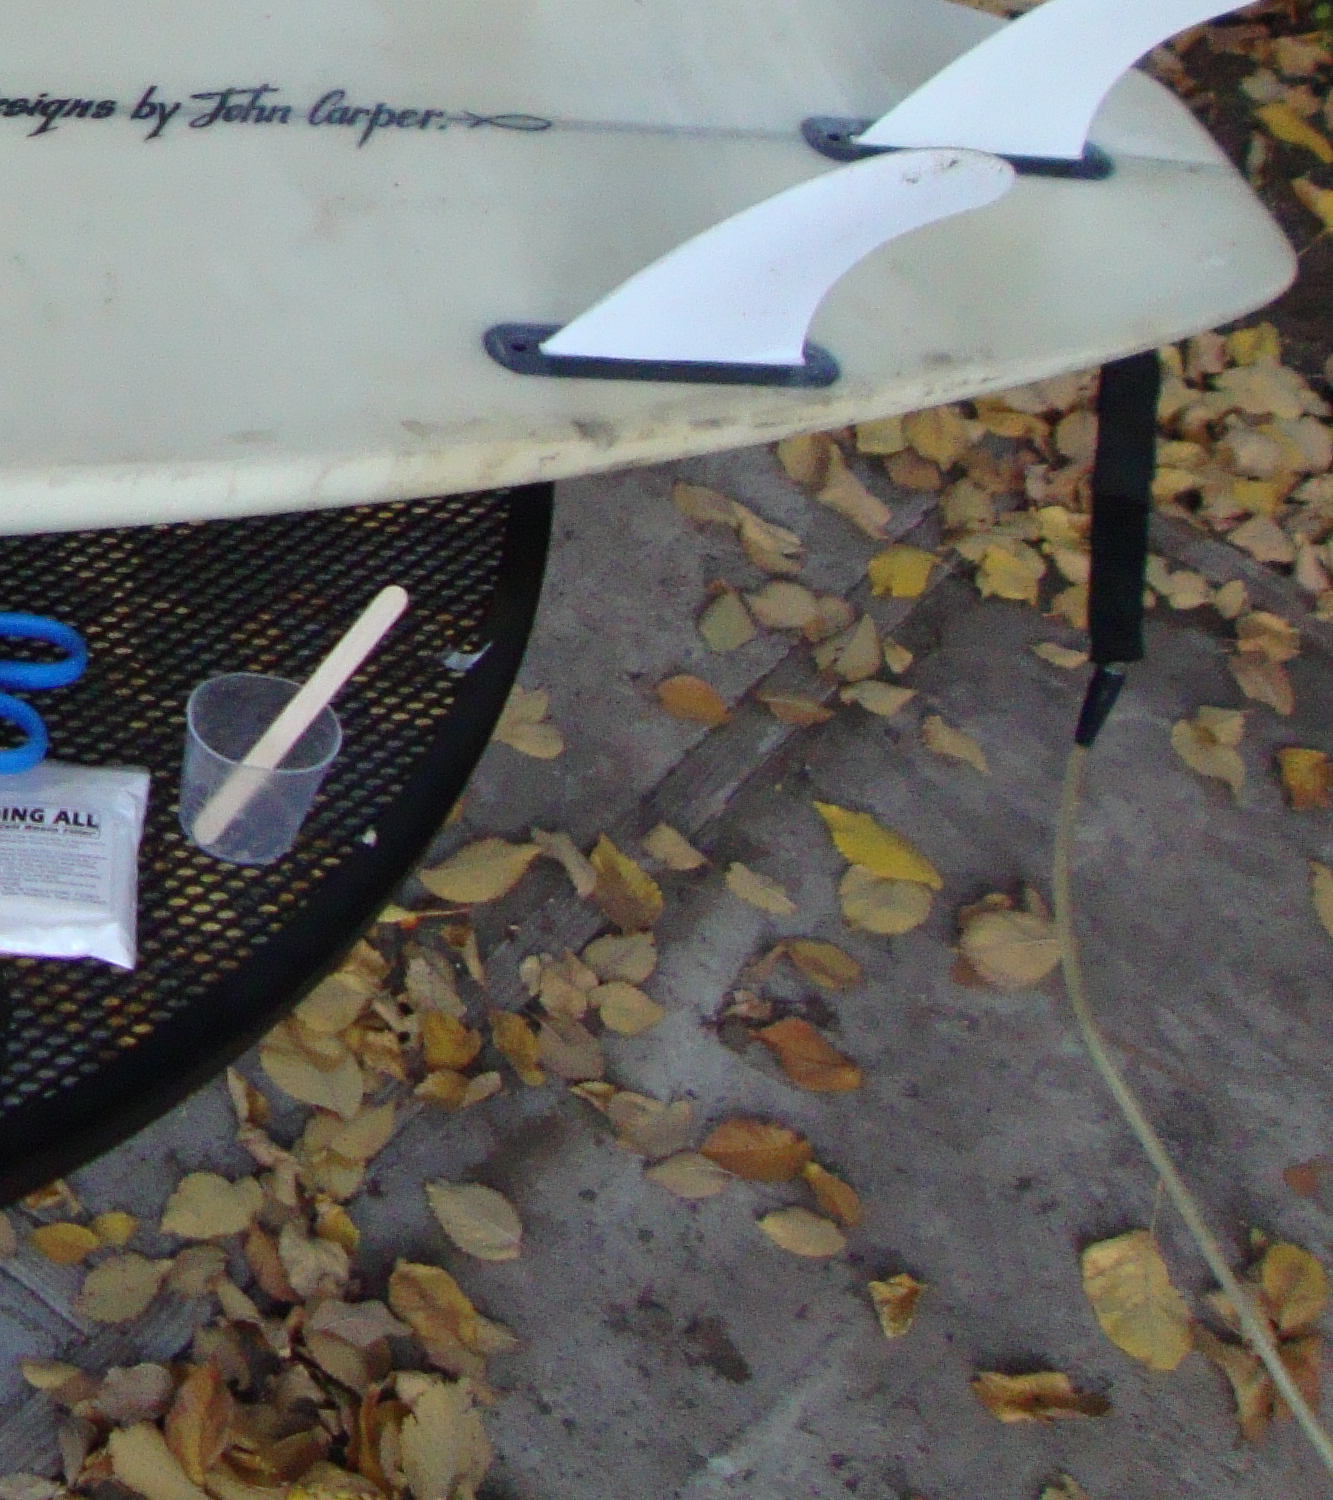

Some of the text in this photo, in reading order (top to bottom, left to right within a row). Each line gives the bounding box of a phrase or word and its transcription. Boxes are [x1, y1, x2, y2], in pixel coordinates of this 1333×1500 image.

[131, 85, 181, 141] by
[188, 82, 290, 130] John
[53, 809, 100, 828] ALL
